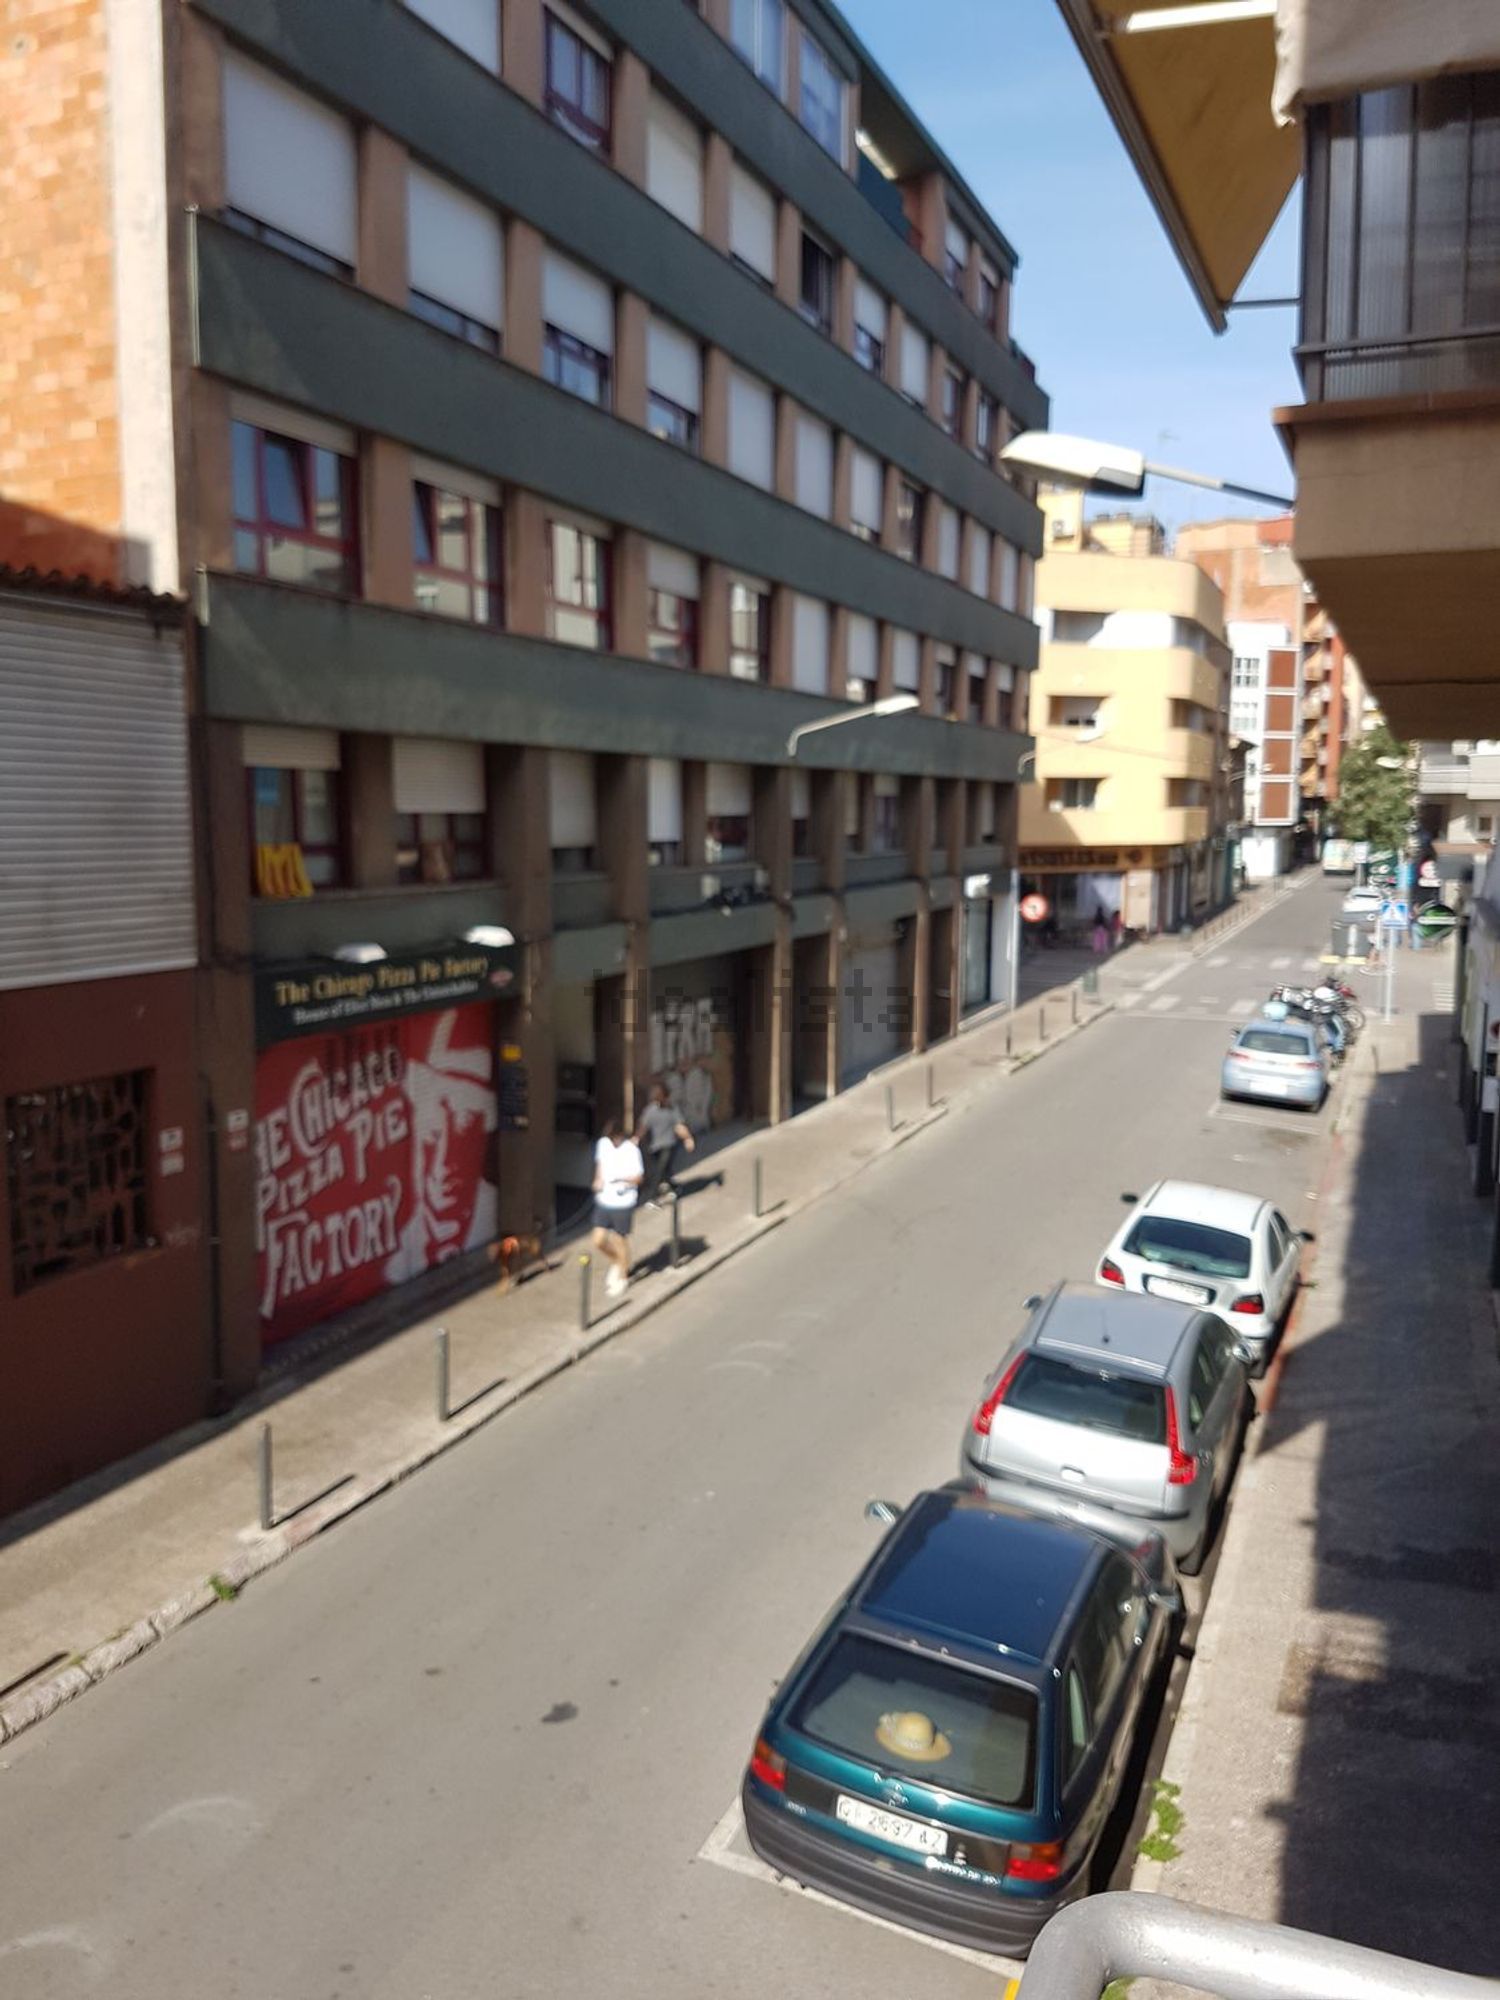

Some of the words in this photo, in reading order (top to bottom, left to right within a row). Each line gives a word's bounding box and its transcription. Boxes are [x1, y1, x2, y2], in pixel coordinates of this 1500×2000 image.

[275, 980, 310, 1006] The
[291, 1045, 402, 1158] CHICAGO
[256, 1142, 345, 1252] PIZZA
[345, 1099, 408, 1184] PIE
[259, 1174, 402, 1319] FACTORY
